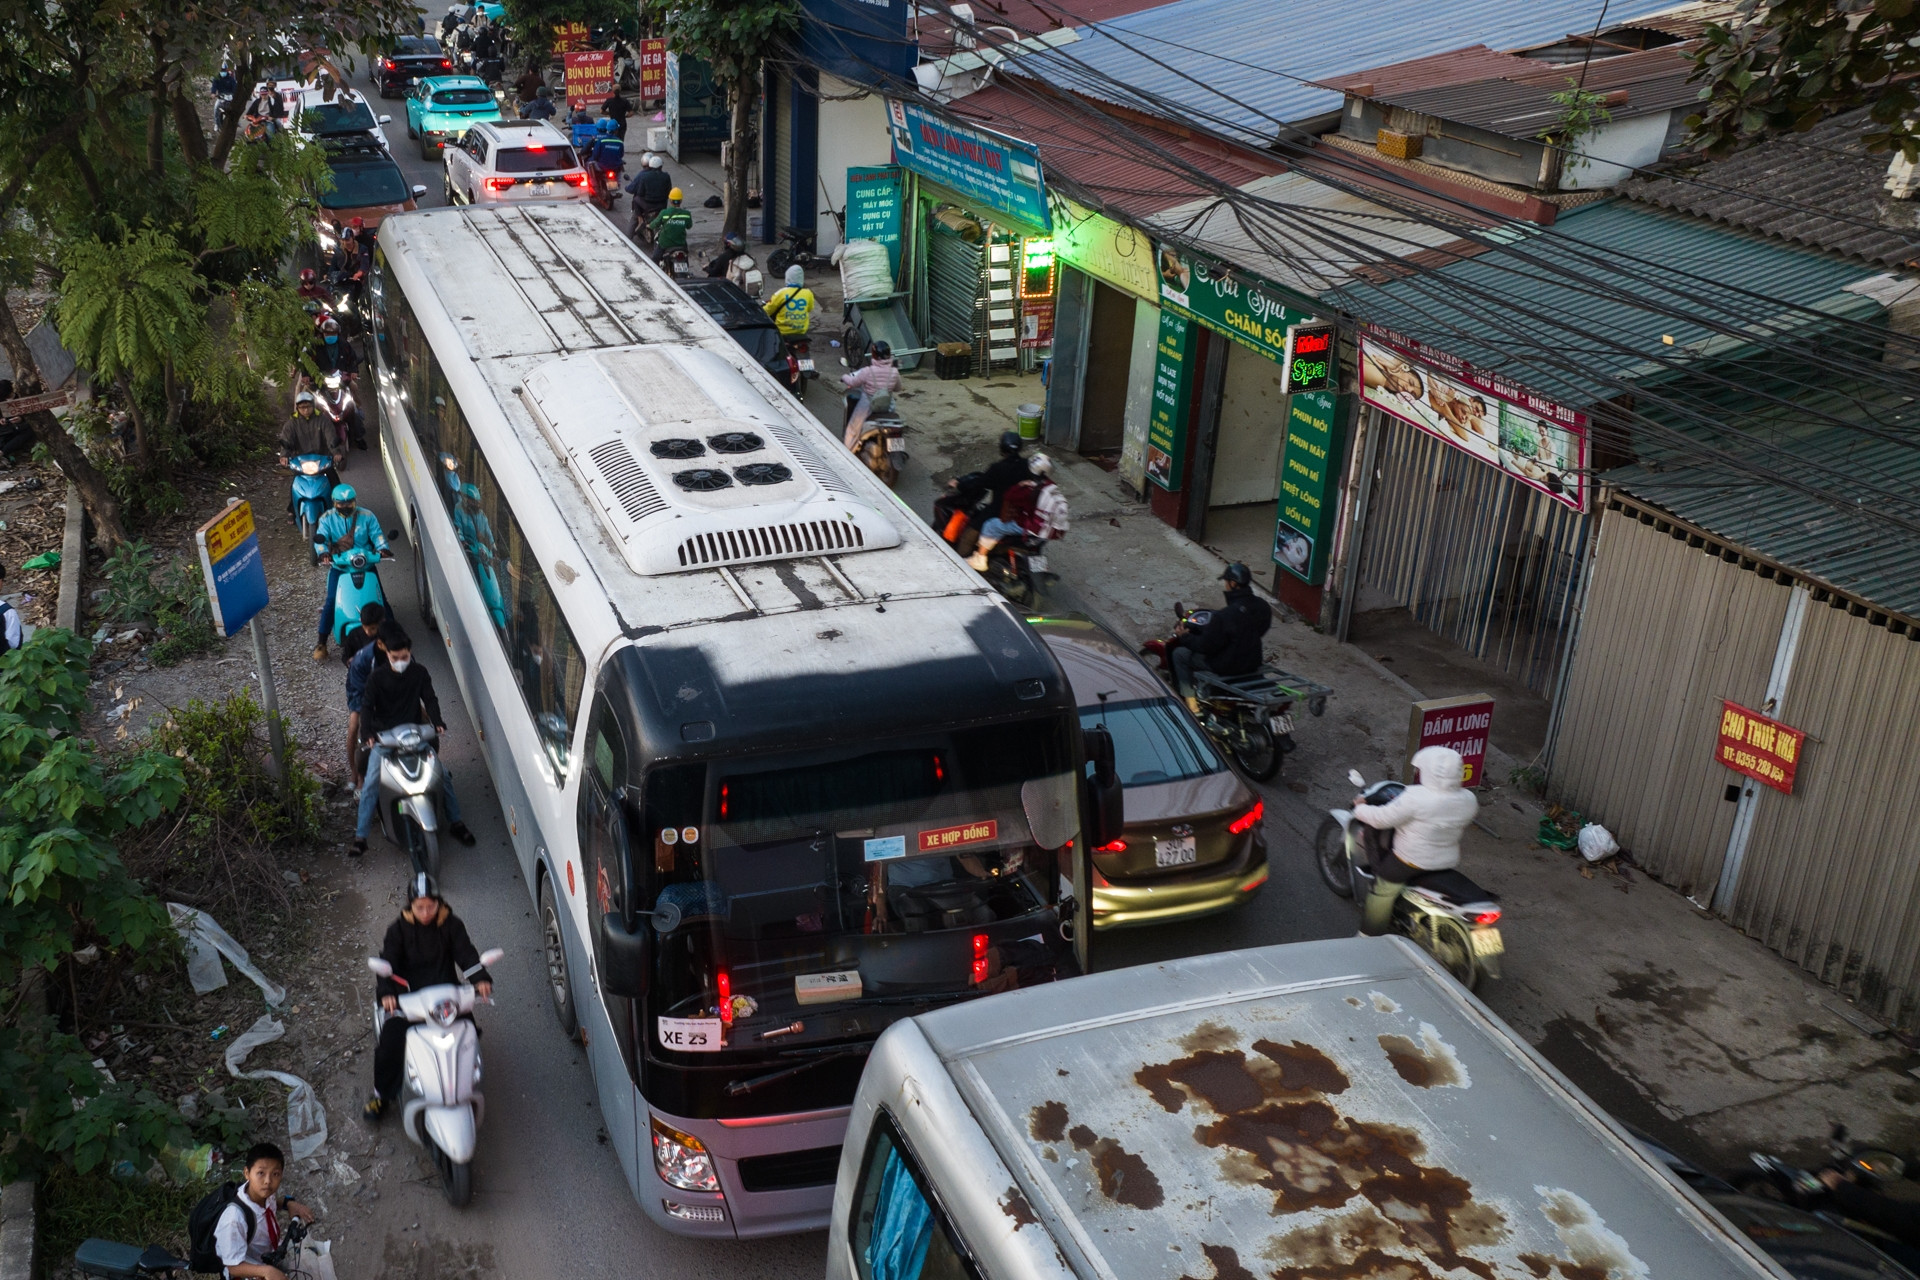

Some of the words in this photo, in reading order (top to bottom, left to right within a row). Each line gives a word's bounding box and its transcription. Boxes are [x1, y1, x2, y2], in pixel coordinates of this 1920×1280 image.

[554, 40, 568, 52] XE
[643, 54, 652, 65] XE
[652, 53, 662, 64] GA
[567, 64, 583, 79] BÚN
[584, 63, 595, 78] BÒ
[596, 60, 611, 77] HUẾ
[654, 69, 662, 80] XE
[568, 81, 583, 96] BÚN
[584, 80, 595, 95] CÁ
[856, 188, 876, 199] CUNG
[876, 185, 894, 197] CẤP:
[862, 200, 878, 209] MÁY
[878, 199, 894, 208] MÓC
[862, 211, 880, 221] DỤNG
[881, 210, 891, 219] CỤ
[862, 222, 874, 232] VẬT
[875, 221, 885, 230] TƯ
[785, 294, 807, 311] be
[785, 311, 807, 320] Food
[1225, 308, 1262, 340] CHĂM
[1292, 358, 1326, 385] Spa
[1292, 407, 1312, 424] PHUN
[1313, 416, 1328, 433] MÔI
[1289, 433, 1309, 450] PHUN
[1289, 458, 1309, 478] PHUN
[1309, 469, 1319, 483] MÍ
[1282, 480, 1300, 498] TRIỆT
[1300, 489, 1321, 509] LÔNG
[1285, 505, 1301, 522] UỐN
[1301, 516, 1311, 528] MI
[1423, 713, 1454, 737] ĐẤM
[1456, 712, 1490, 733] LƯNG
[1721, 709, 1746, 741] CHO
[1746, 718, 1776, 753] THUÊ
[1775, 733, 1797, 763] NHÀ
[1452, 736, 1484, 757] GIÃN
[1735, 750, 1757, 770] 0355
[1756, 758, 1771, 776] 288
[927, 834, 939, 846] XE
[941, 831, 961, 845] HỢP
[963, 824, 990, 840] ĐỒNG
[663, 1030, 683, 1045] XE
